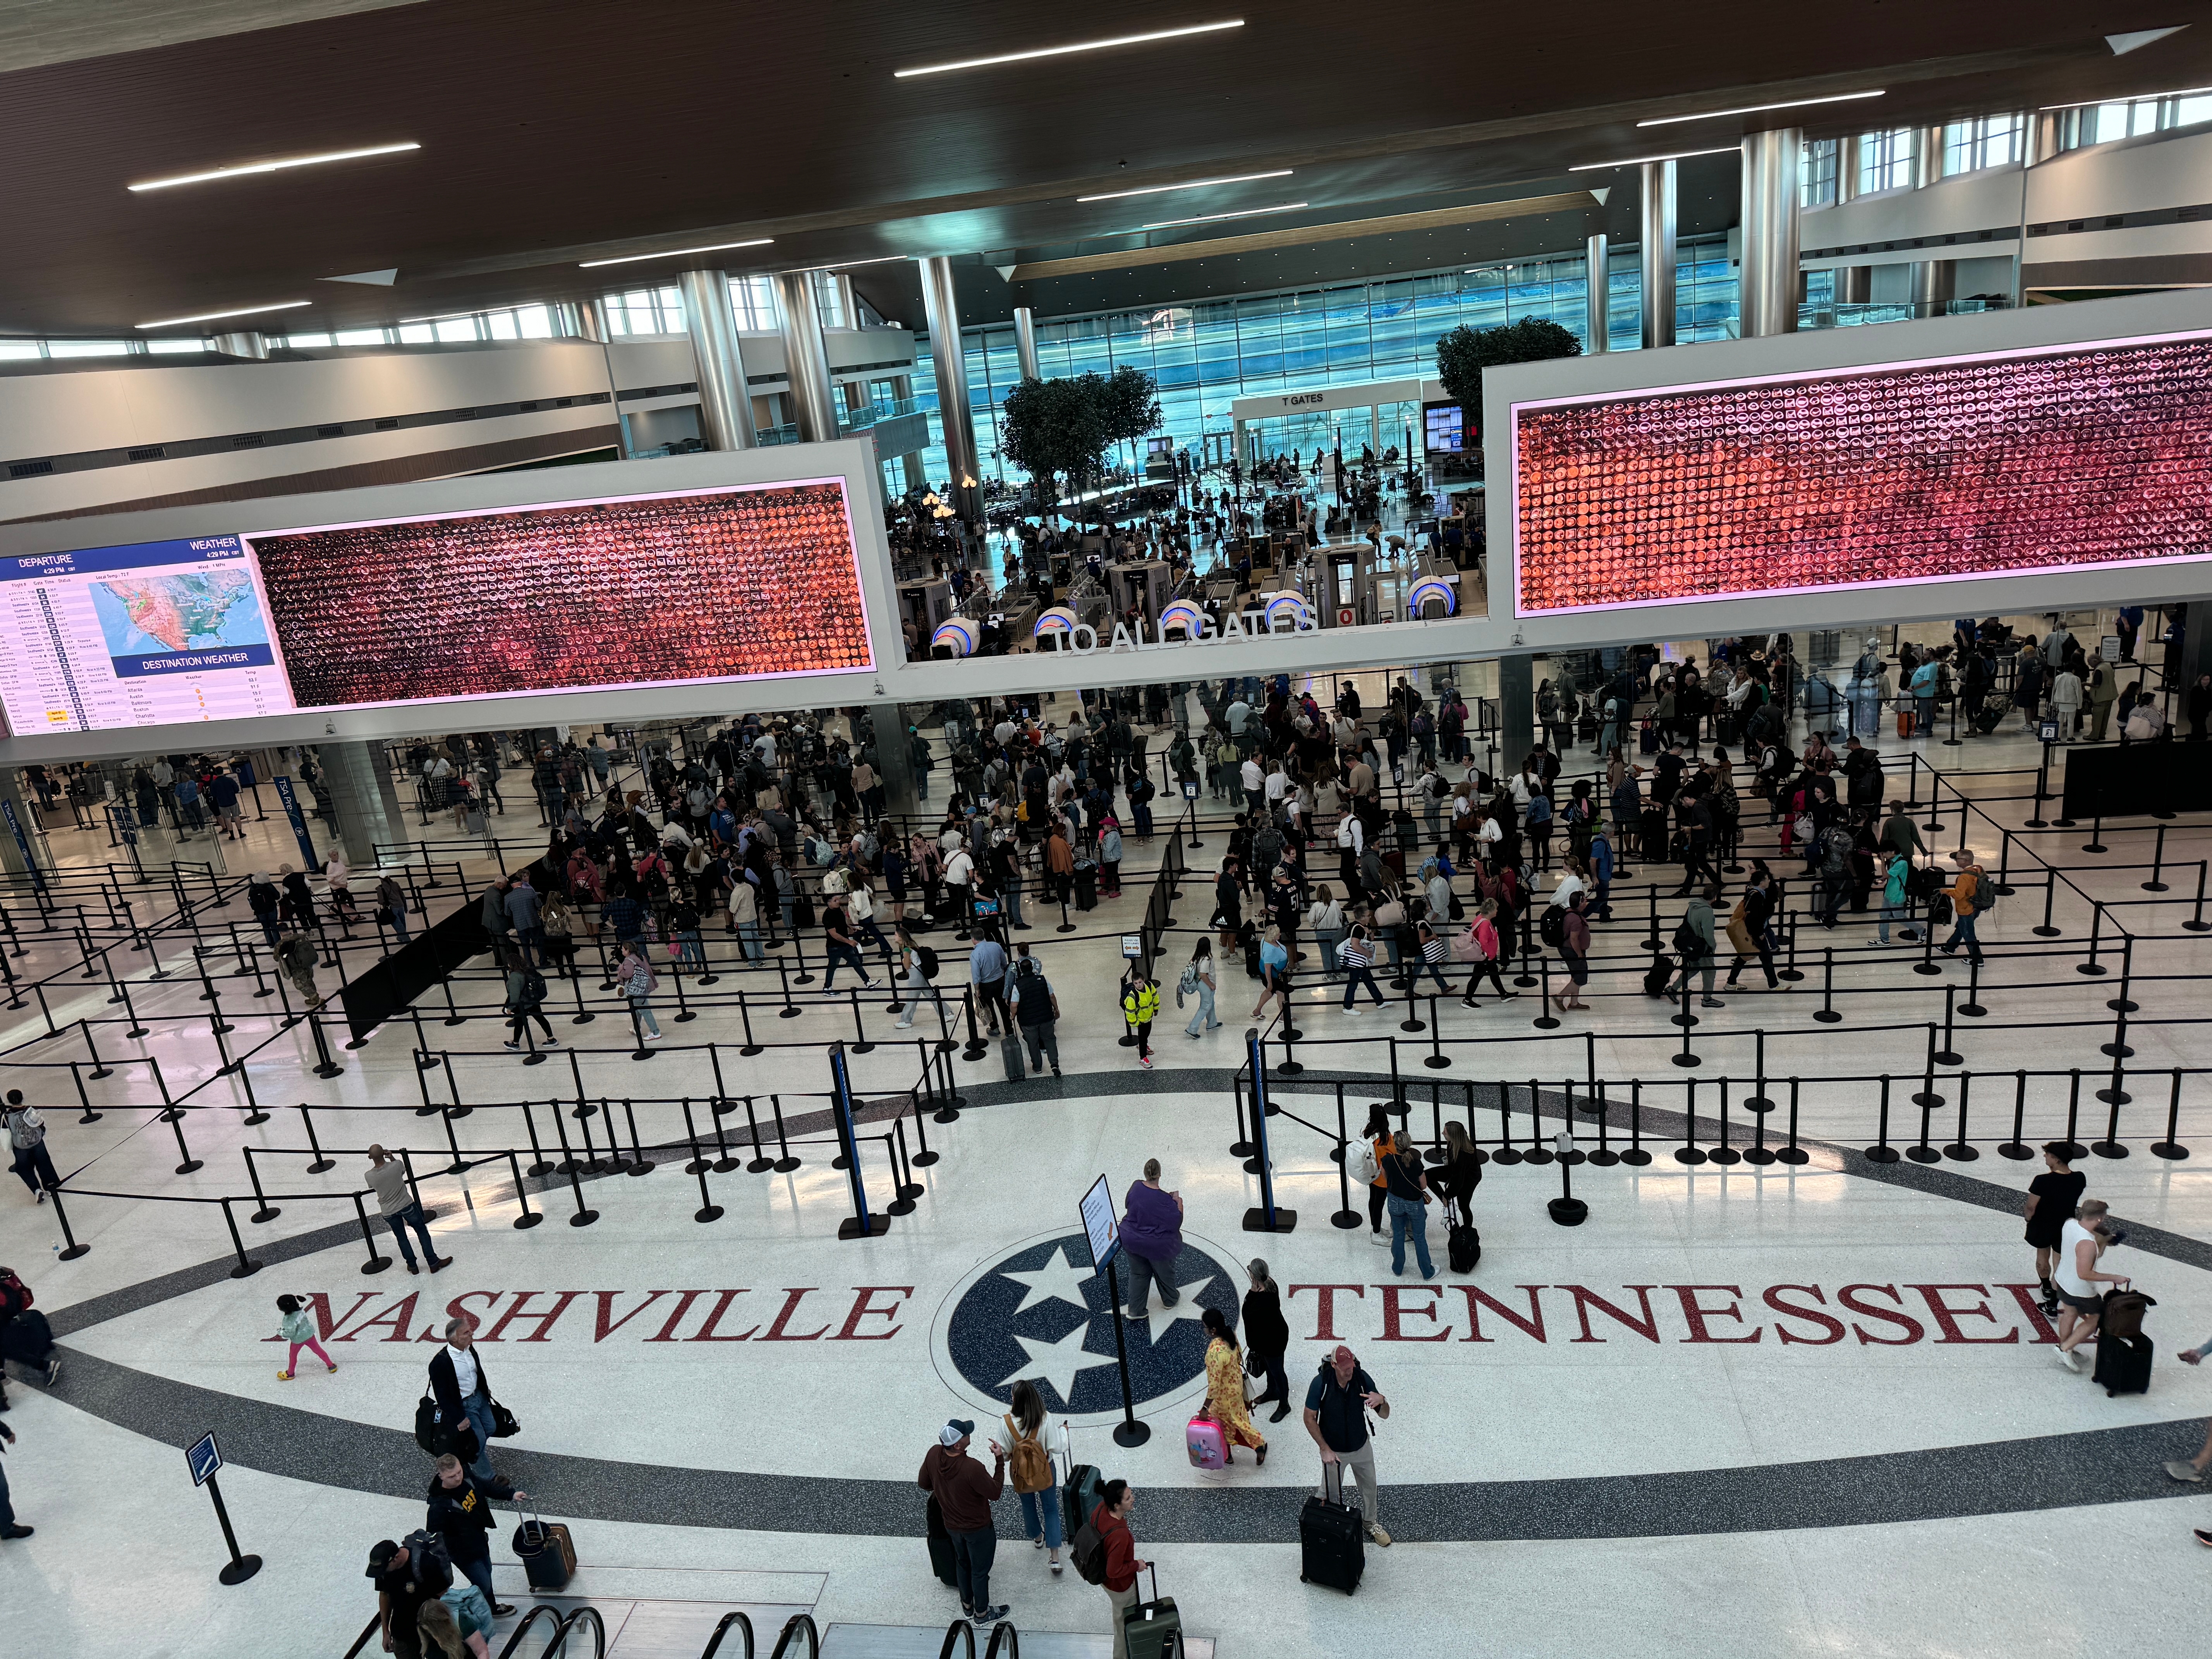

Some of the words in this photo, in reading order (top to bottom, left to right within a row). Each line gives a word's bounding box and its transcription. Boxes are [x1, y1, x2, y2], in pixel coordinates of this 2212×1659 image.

[1282, 397, 1288, 406] T
[1291, 393, 1323, 405] GATES
[190, 538, 237, 550] WEATHER
[18, 554, 73, 568] DEPARTURE
[1044, 624, 1097, 658] TO
[1109, 618, 1180, 653] ALL
[1190, 604, 1319, 646] GATES
[143, 656, 202, 670] DESTINATION
[204, 653, 249, 665] WEATHER
[279, 779, 289, 795] TSA
[284, 797, 292, 810] Pre
[1291, 893, 1299, 911] 51
[261, 1286, 915, 1343] NASHVILLE
[462, 1489, 477, 1513] CAT
